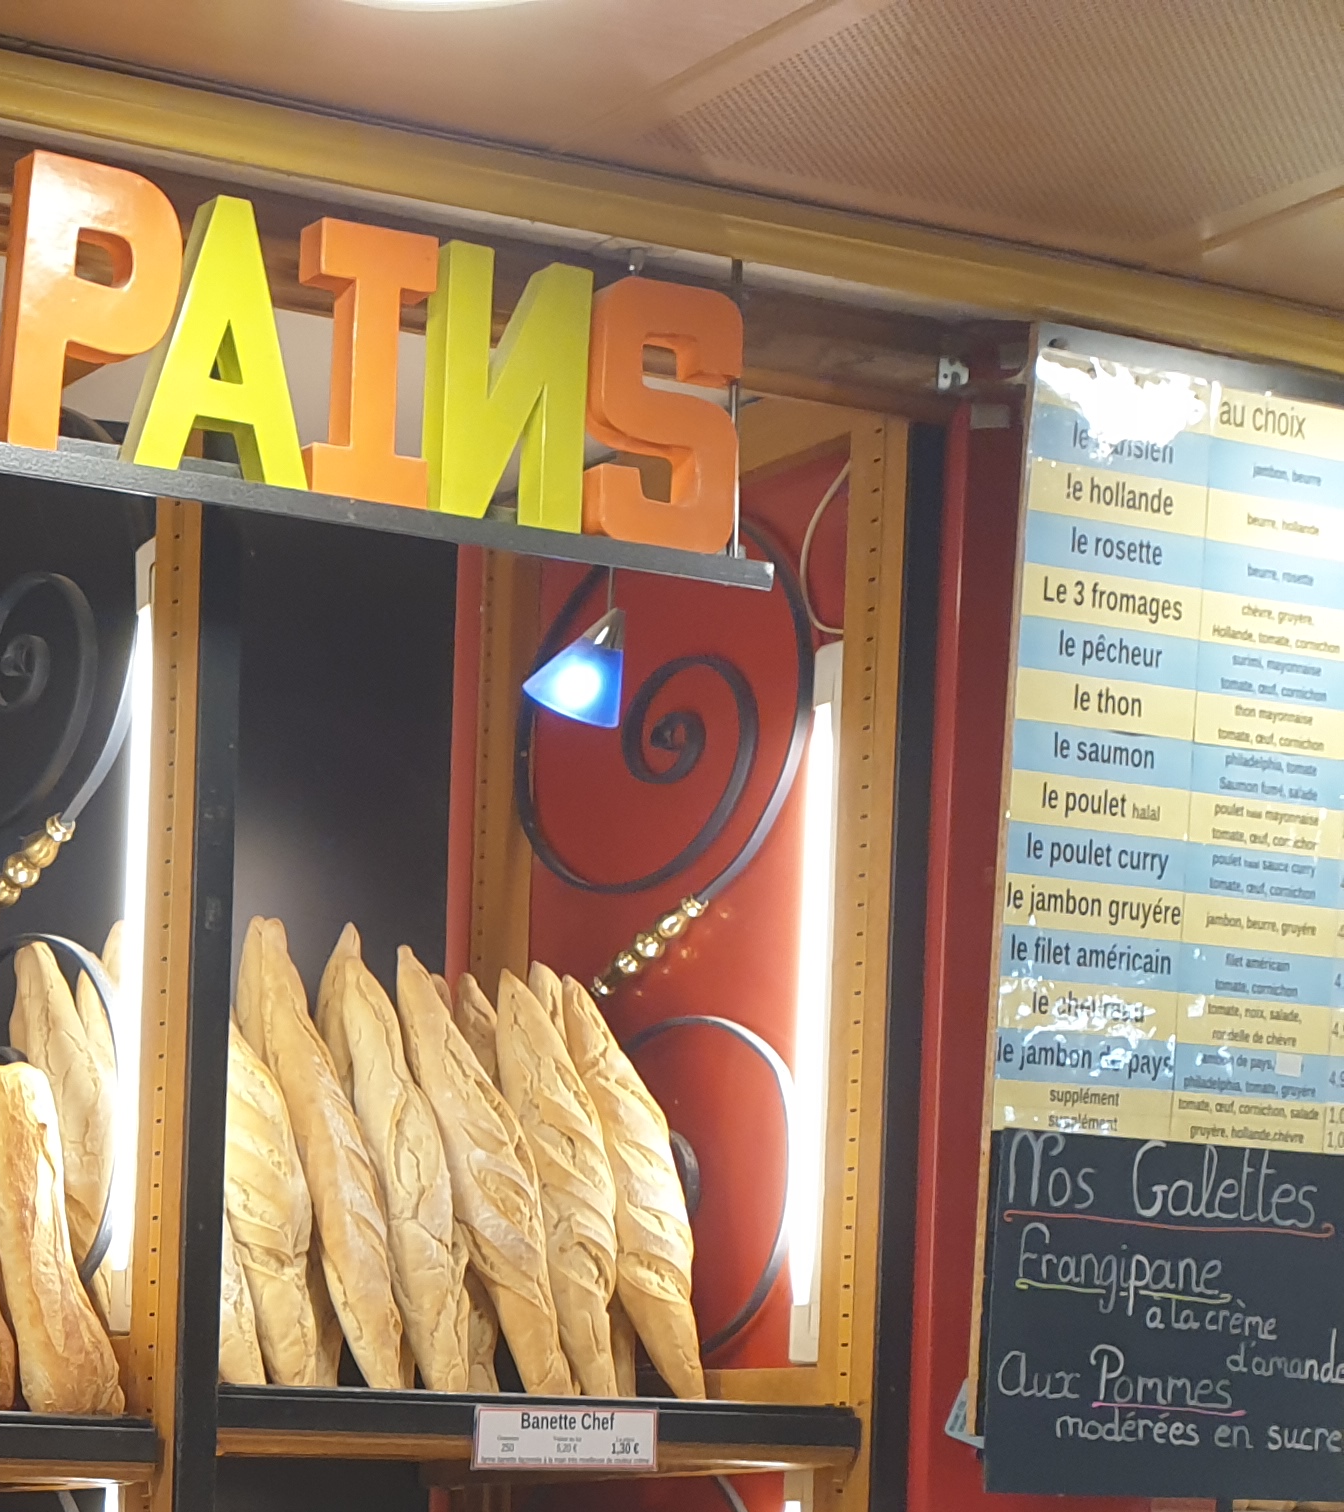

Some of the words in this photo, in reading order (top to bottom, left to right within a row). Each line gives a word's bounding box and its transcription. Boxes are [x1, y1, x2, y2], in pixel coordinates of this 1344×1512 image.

[1219, 401, 1245, 428] au
[1252, 405, 1307, 440] choix
[1090, 476, 1174, 516] hollande
[1071, 526, 1088, 555] le
[1094, 533, 1163, 566] rosette
[1043, 576, 1067, 603] Le
[1074, 580, 1085, 604] 3
[1092, 583, 1183, 624] fromages
[1059, 629, 1075, 656] le
[1082, 634, 1162, 669] pêcheur
[1074, 684, 1091, 711] le
[1097, 687, 1142, 717] thon
[1054, 731, 1069, 758] le
[1077, 740, 1155, 769] saumon
[1043, 782, 1059, 809] le
[1065, 788, 1126, 818] poulet
[1132, 802, 1161, 822] halal
[1027, 832, 1043, 859] le
[1050, 838, 1111, 867] poulet
[1118, 848, 1169, 880] curry
[1007, 882, 1023, 908] le
[1028, 884, 1102, 917] jambon
[1011, 934, 1027, 961] le
[1034, 939, 1071, 965] filet
[1077, 943, 1171, 975] américain
[1032, 991, 1049, 1015] le
[997, 1037, 1014, 1063] le
[1019, 1044, 1092, 1070] jambon
[1050, 1088, 1120, 1107] supplément
[1007, 1129, 1096, 1210] Nos
[1132, 1139, 1318, 1229] Galettes
[1017, 1221, 1224, 1317] Frangipane
[1171, 1298, 1200, 1330] la
[1205, 1298, 1279, 1341] crème
[997, 1350, 1082, 1400] Aux
[1089, 1343, 1233, 1409] Pommes
[521, 1412, 576, 1430] Banette
[581, 1412, 615, 1430] Chef
[1055, 1410, 1201, 1447] modérées
[1214, 1423, 1254, 1450] en
[1267, 1423, 1344, 1453] sucre
[611, 1443, 631, 1455] 1,30
[633, 1443, 639, 1455] €
